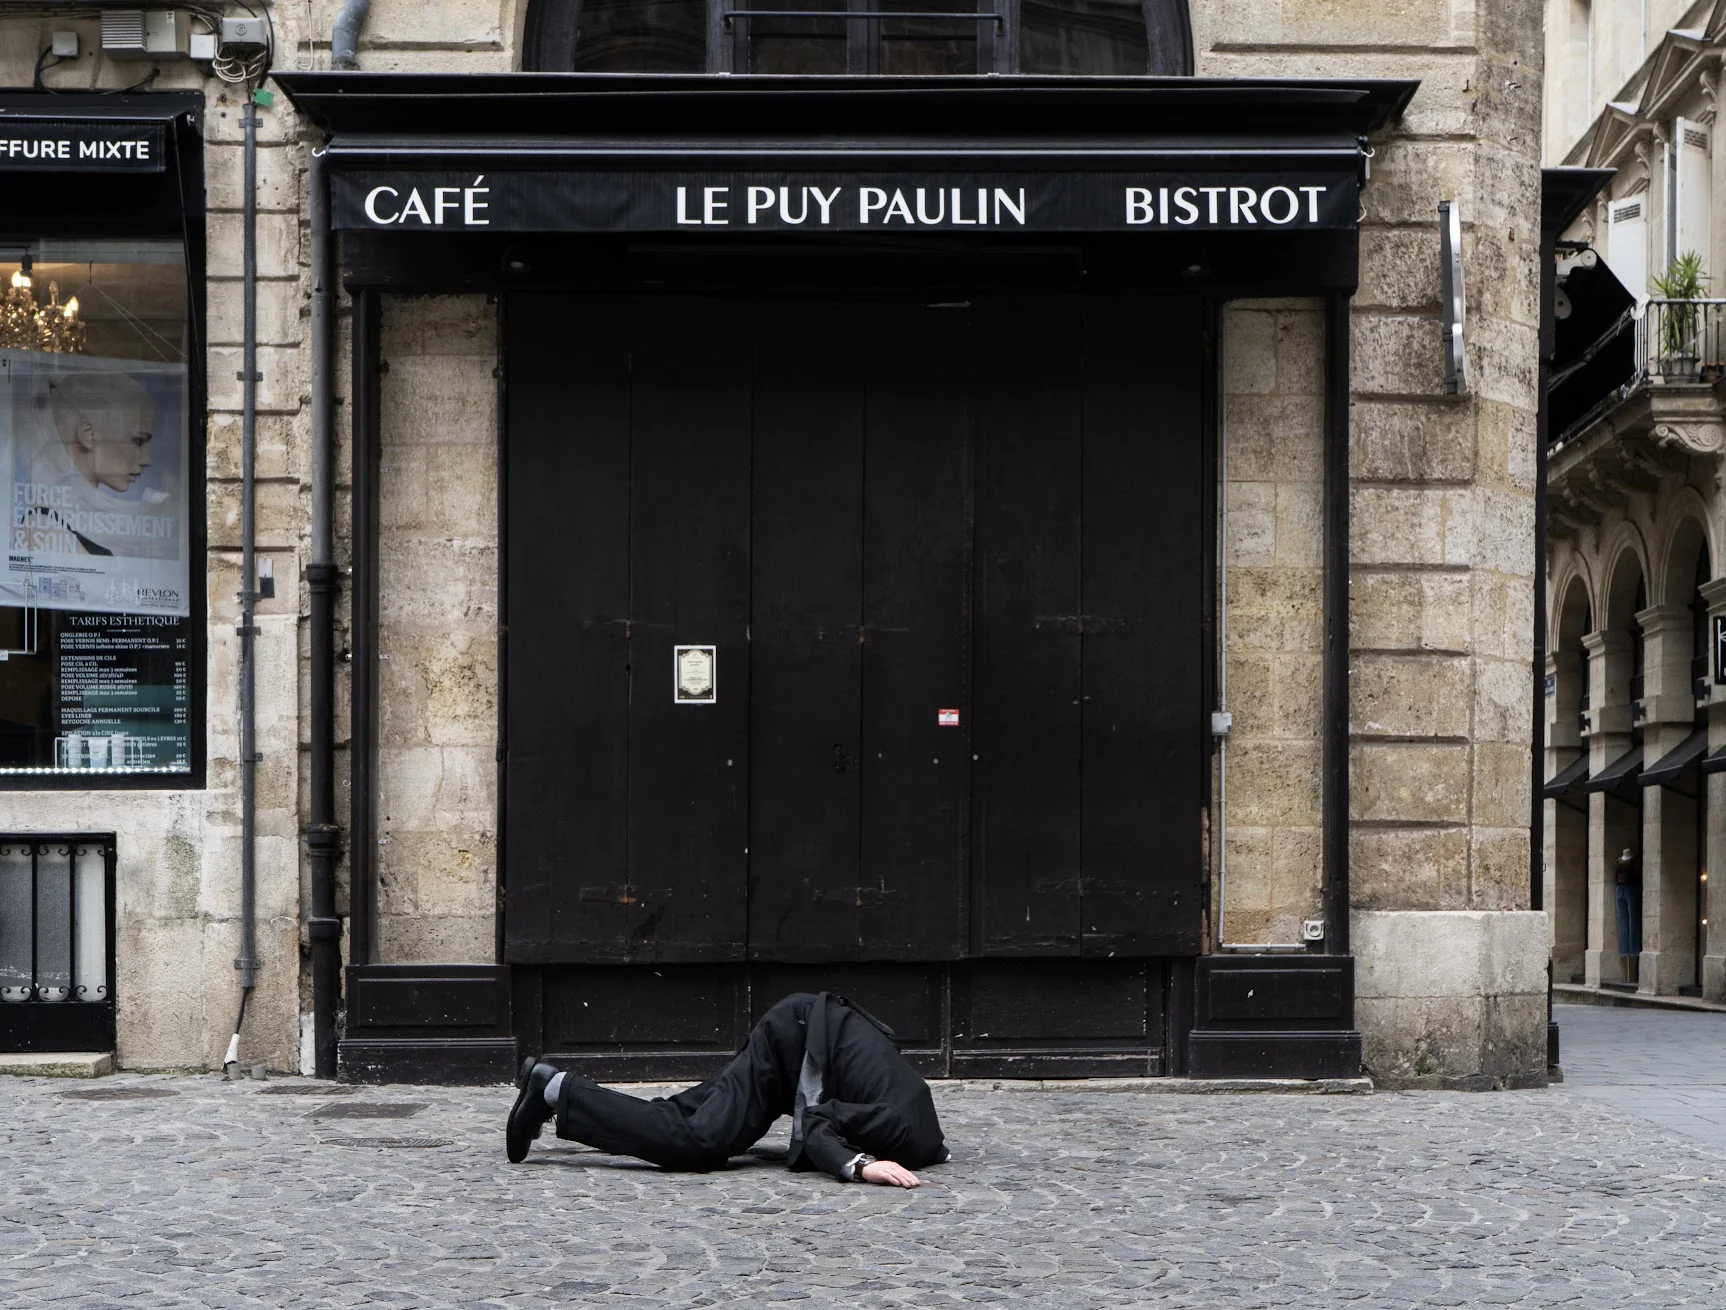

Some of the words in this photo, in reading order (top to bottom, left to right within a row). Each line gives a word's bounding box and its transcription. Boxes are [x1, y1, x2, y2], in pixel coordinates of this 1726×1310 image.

[79, 140, 149, 159] MIXTE
[364, 175, 490, 224] CAFÉ
[677, 186, 729, 224] LE
[748, 186, 841, 224] PUY
[860, 187, 1025, 224] PAULIN
[1126, 186, 1326, 224] BISTROT
[14, 530, 28, 550] &
[32, 530, 76, 554] SOIN
[138, 588, 179, 598] REVLON
[70, 616, 107, 626] TARIFS
[110, 616, 180, 627] ESTHETIQUE
